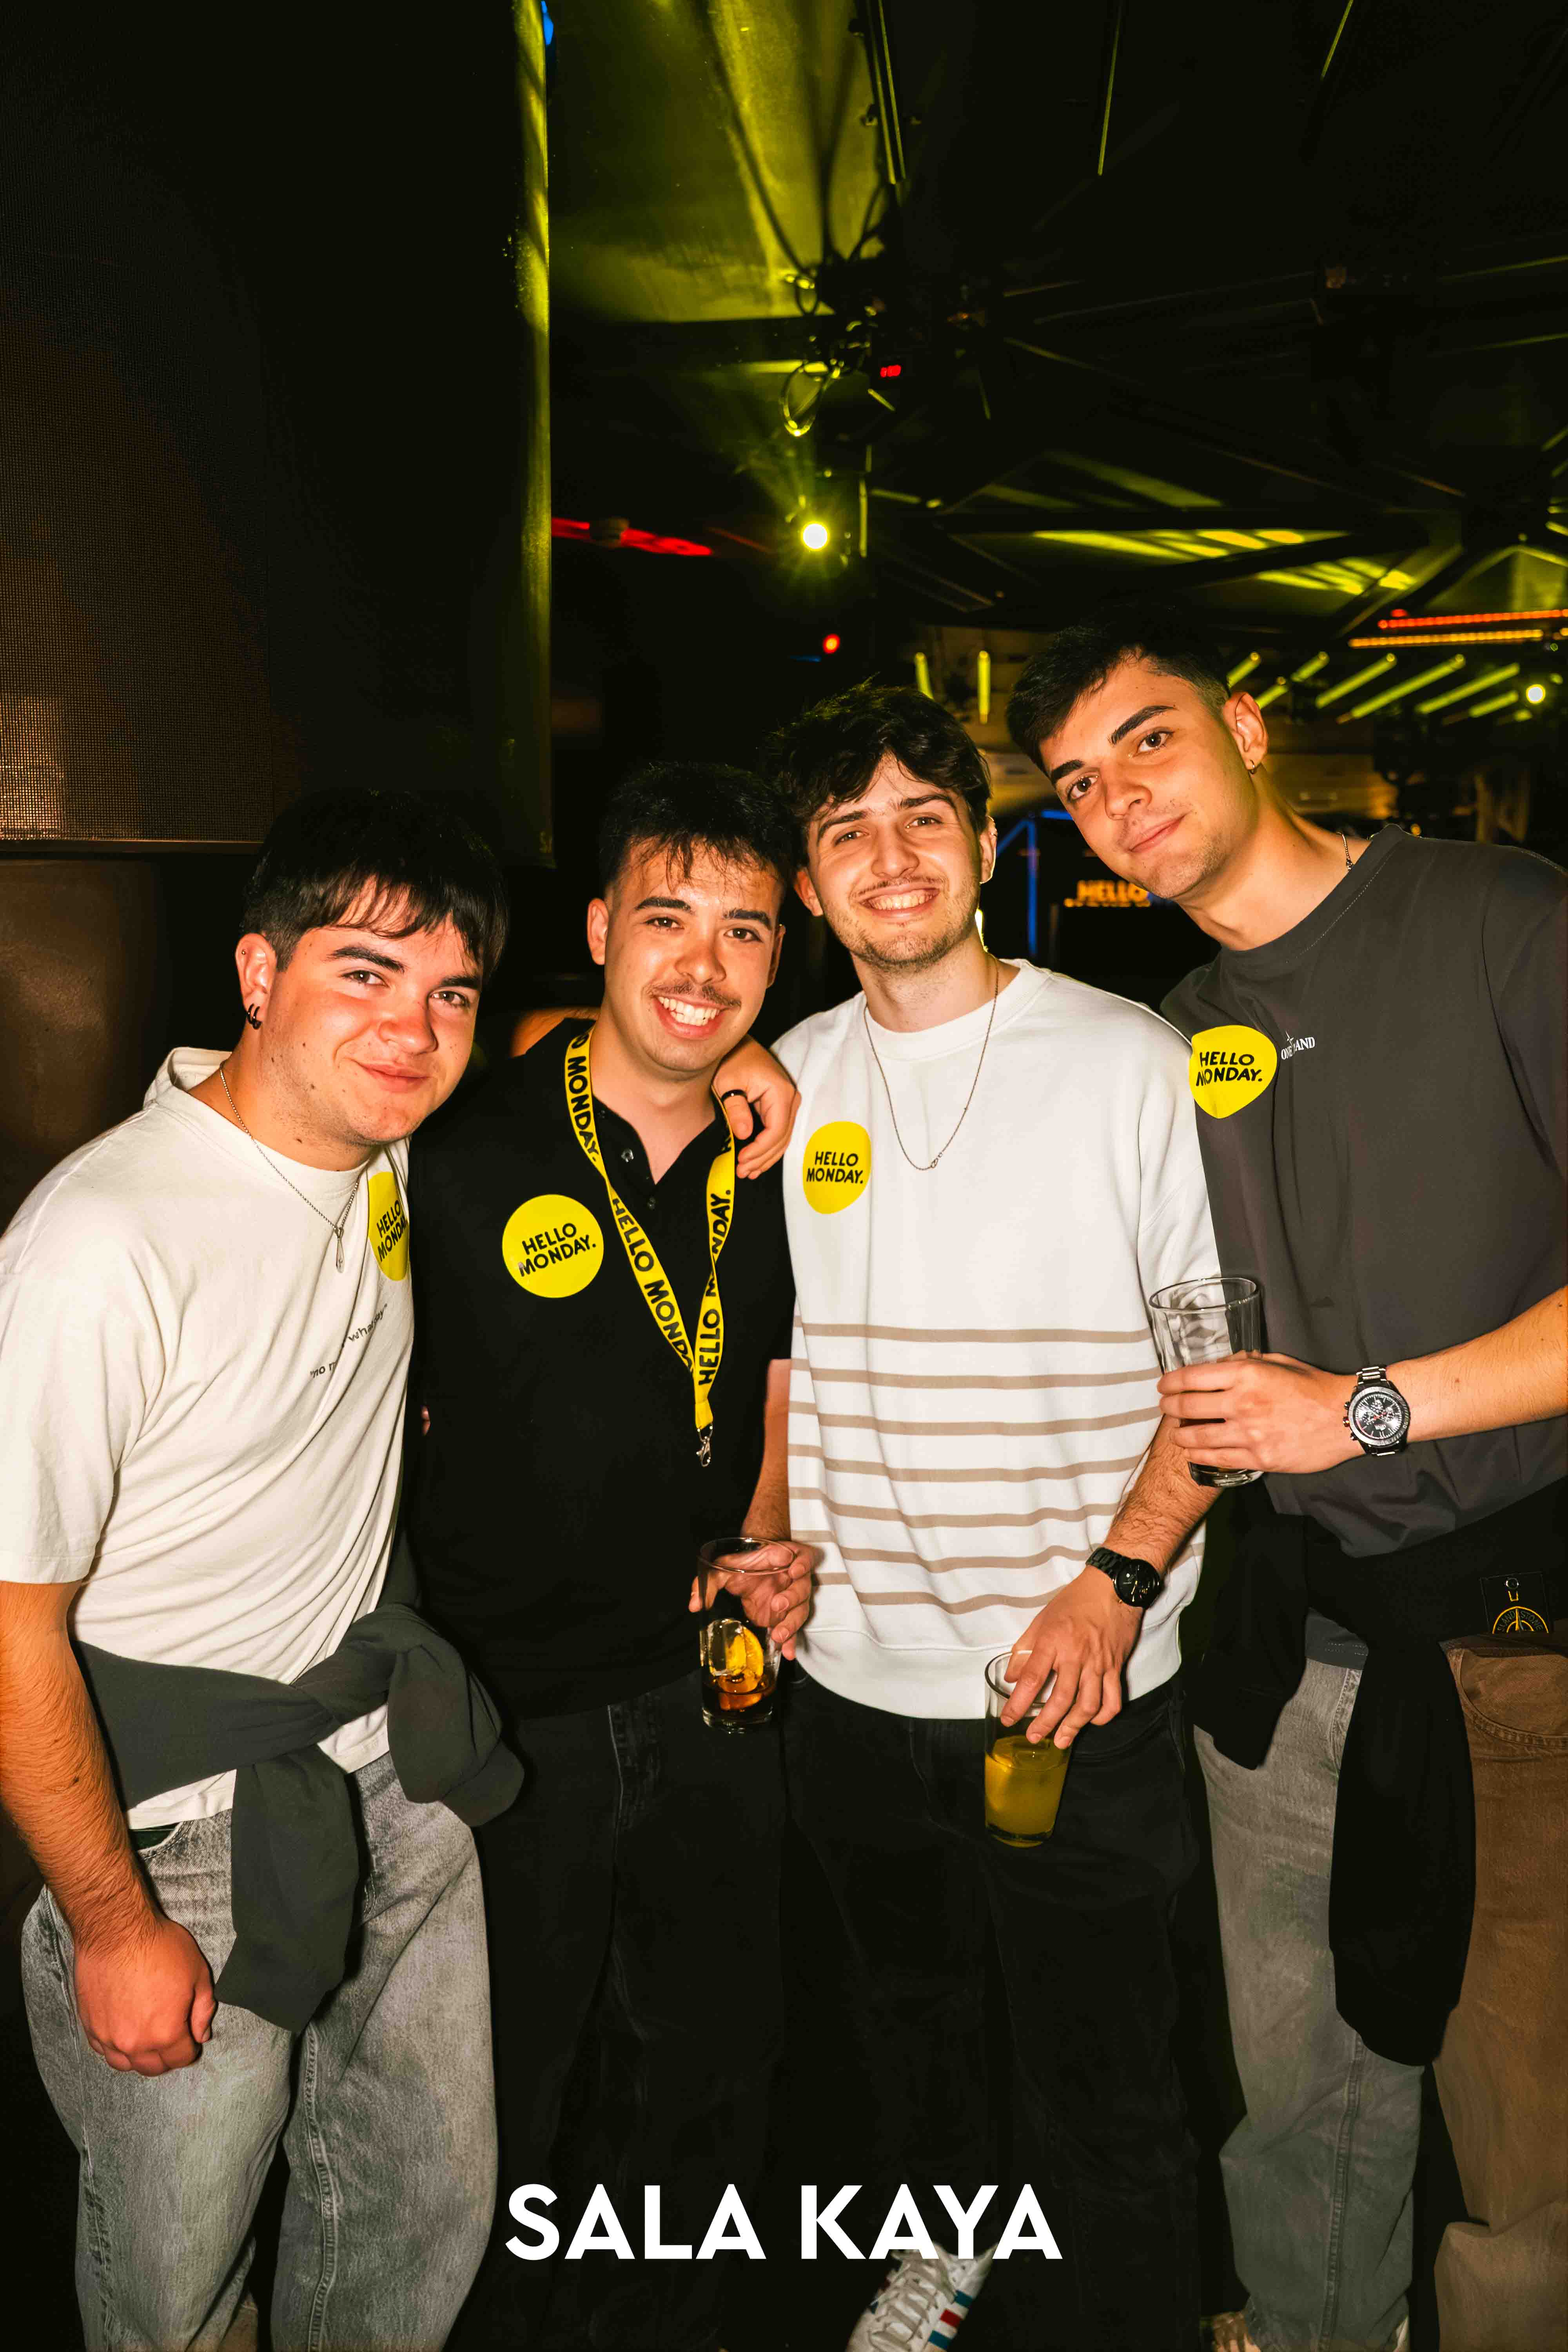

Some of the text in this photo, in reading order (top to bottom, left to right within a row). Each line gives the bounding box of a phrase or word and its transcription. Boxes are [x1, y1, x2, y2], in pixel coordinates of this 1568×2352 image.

[1200, 1051, 1254, 1067] HELLO
[1281, 1045, 1292, 1060] ONE
[1196, 1067, 1263, 1087] MONDAY.
[568, 1056, 599, 1162] MONDAY.
[815, 1151, 858, 1167] HELLO
[806, 1168, 863, 1184] MONDAY.
[377, 1200, 401, 1238] HELLO
[522, 1223, 577, 1255] HELLO
[518, 1234, 596, 1277] MONDAY.
[613, 1198, 692, 1372] HELLO MONDA
[699, 1308, 720, 1385] HELLO
